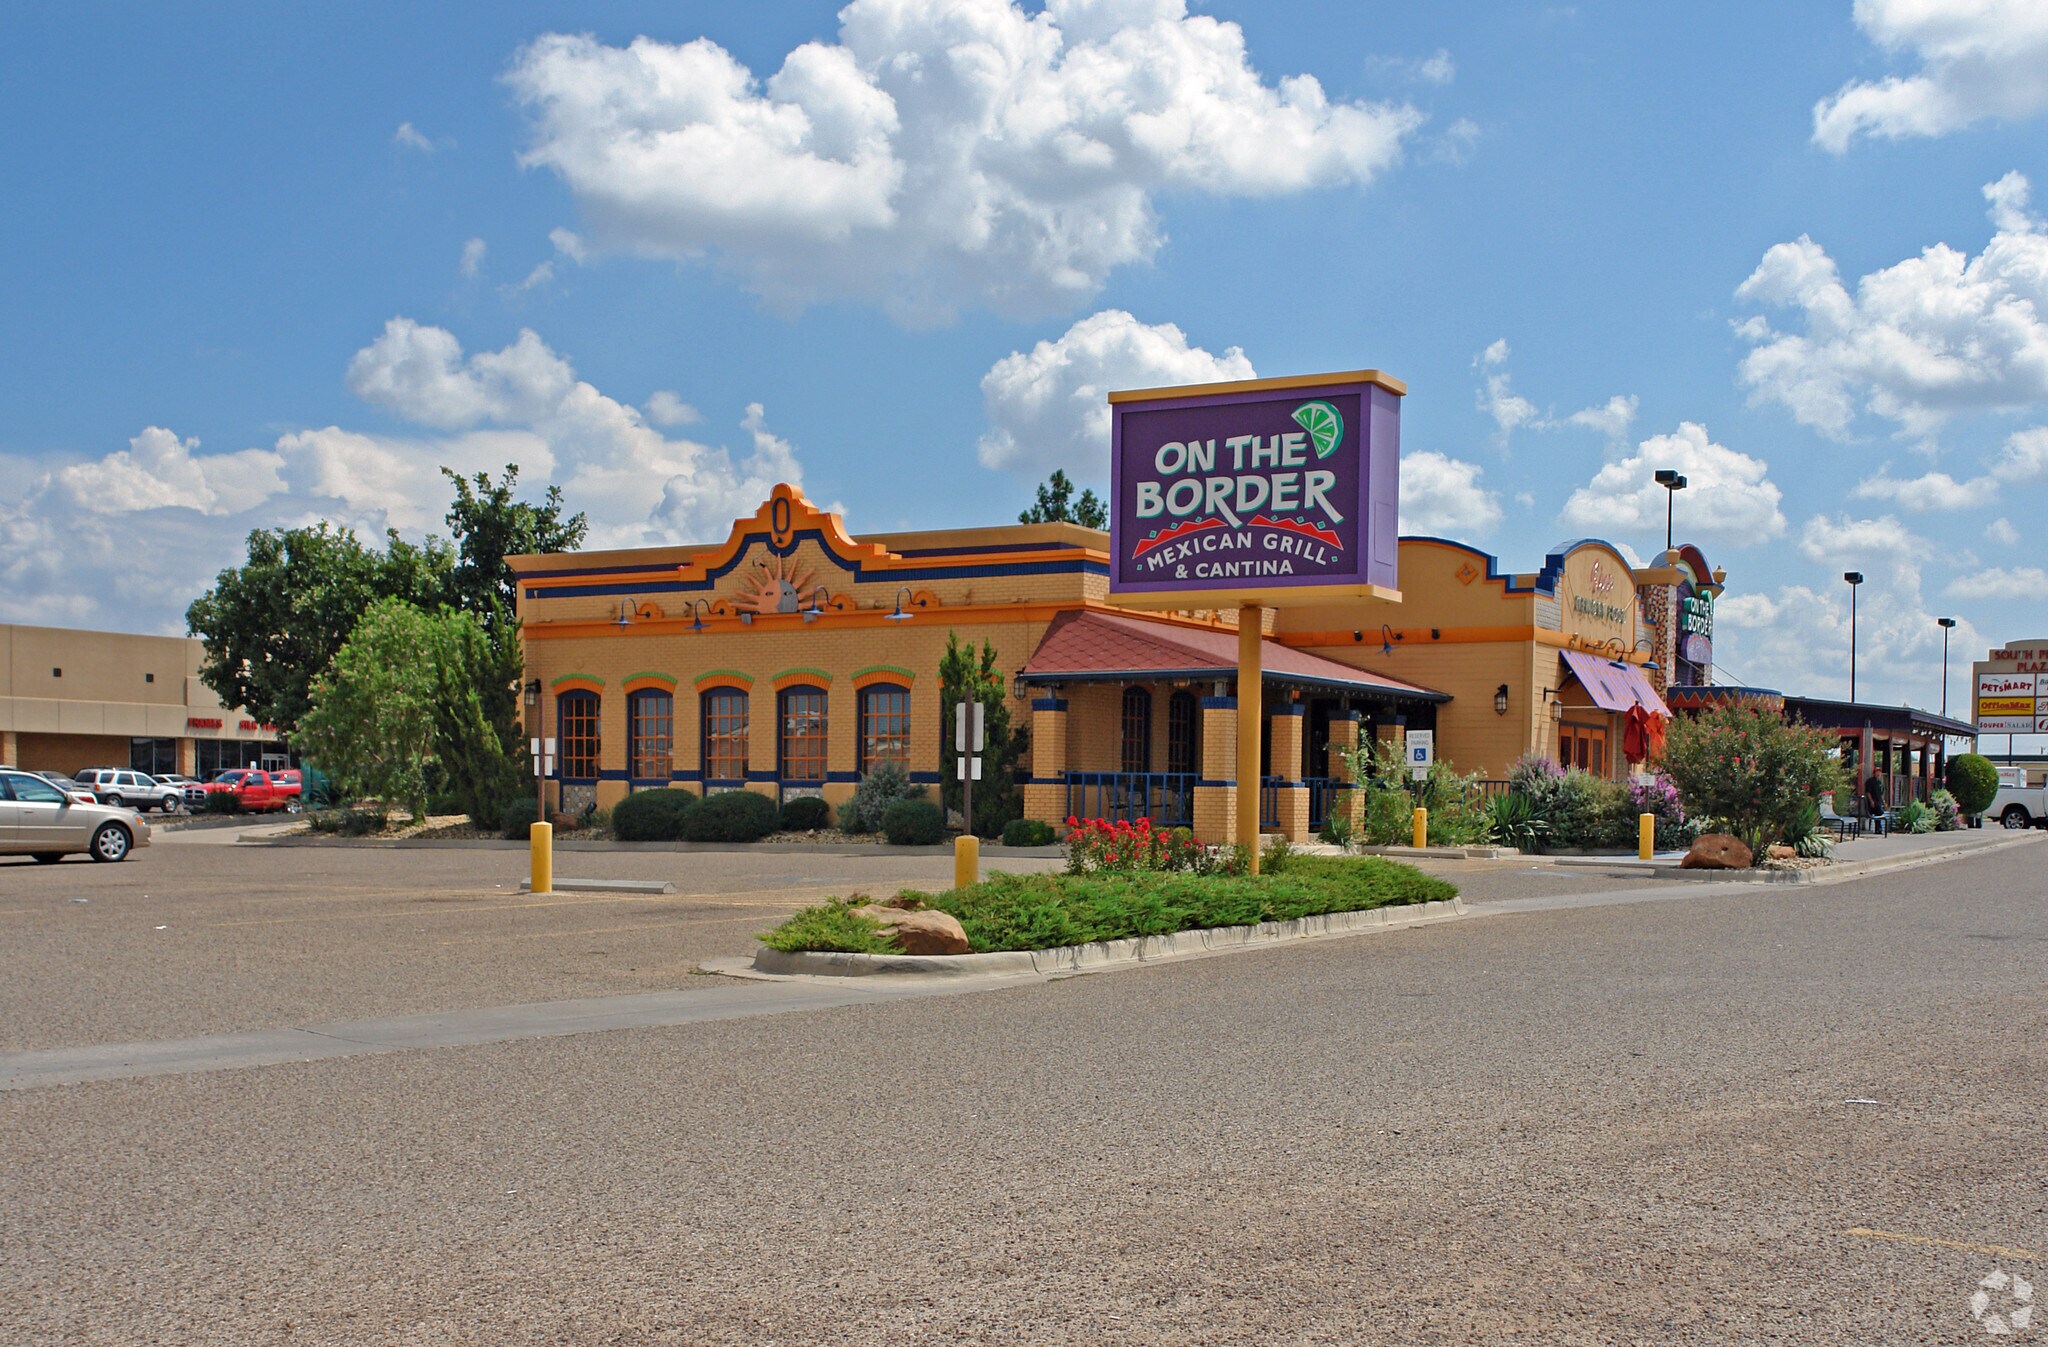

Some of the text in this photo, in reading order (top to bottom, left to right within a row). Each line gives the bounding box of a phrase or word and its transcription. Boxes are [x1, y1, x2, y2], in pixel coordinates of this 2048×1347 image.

[1155, 432, 1307, 475] ON THE
[1136, 470, 1344, 529] BORDER
[1147, 532, 1326, 571] MEXICAN GRILL
[1175, 559, 1294, 579] & CANTINA
[1690, 597, 1699, 613] ON
[1994, 649, 2033, 660] SOUTH
